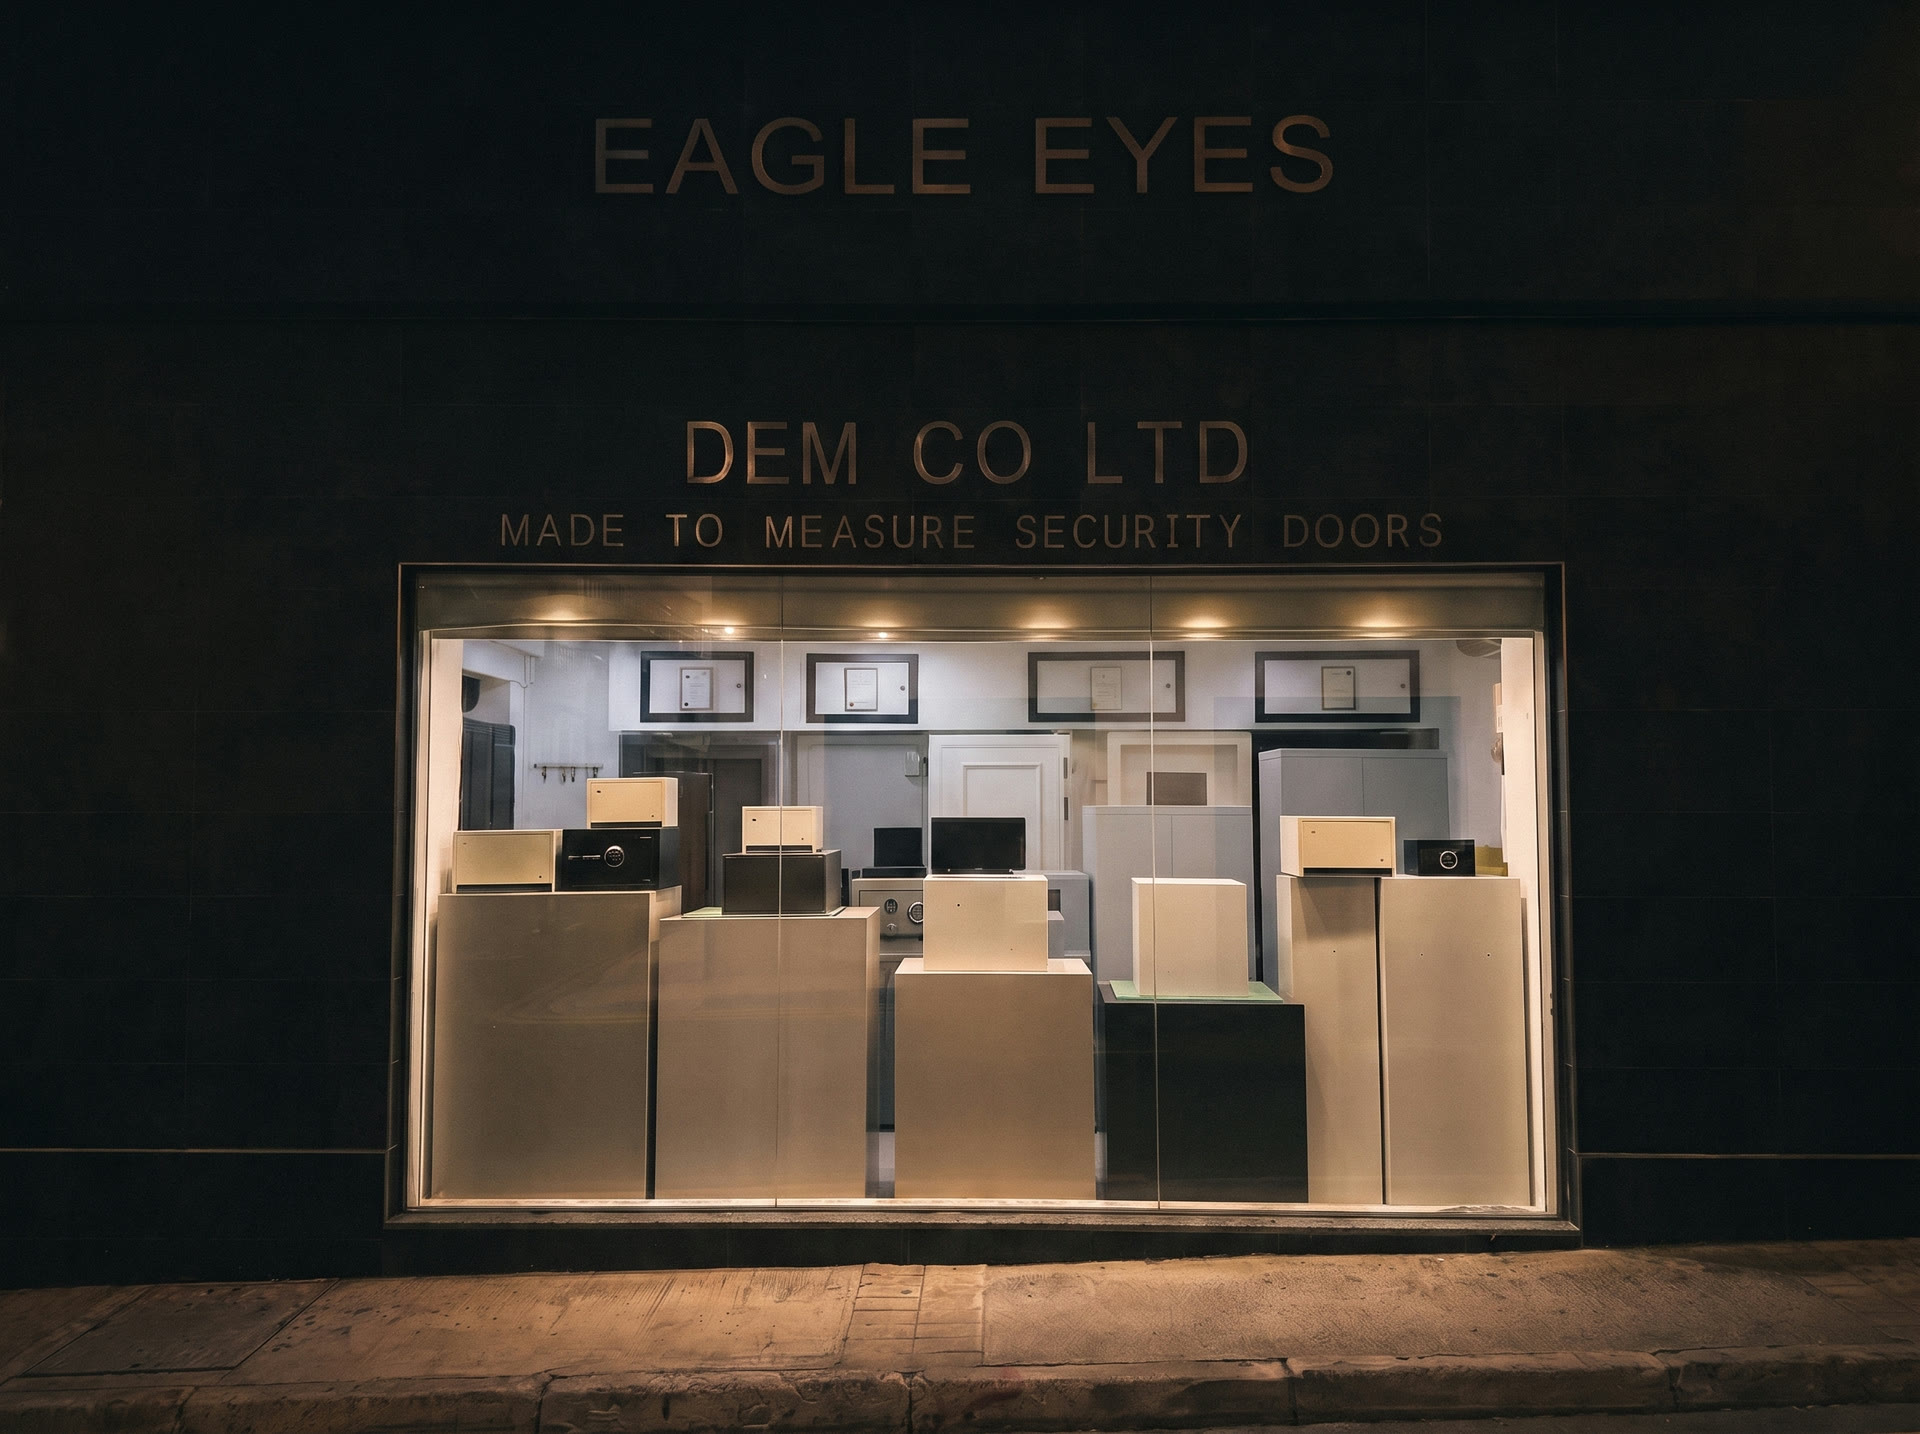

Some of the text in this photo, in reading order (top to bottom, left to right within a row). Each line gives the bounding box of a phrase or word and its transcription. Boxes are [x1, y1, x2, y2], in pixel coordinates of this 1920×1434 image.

[594, 115, 1334, 195] EAGLE EYES
[685, 420, 1249, 485] DEM CO LTD
[500, 513, 1444, 549] MADE TO MEASURE SECURITY DOORS
